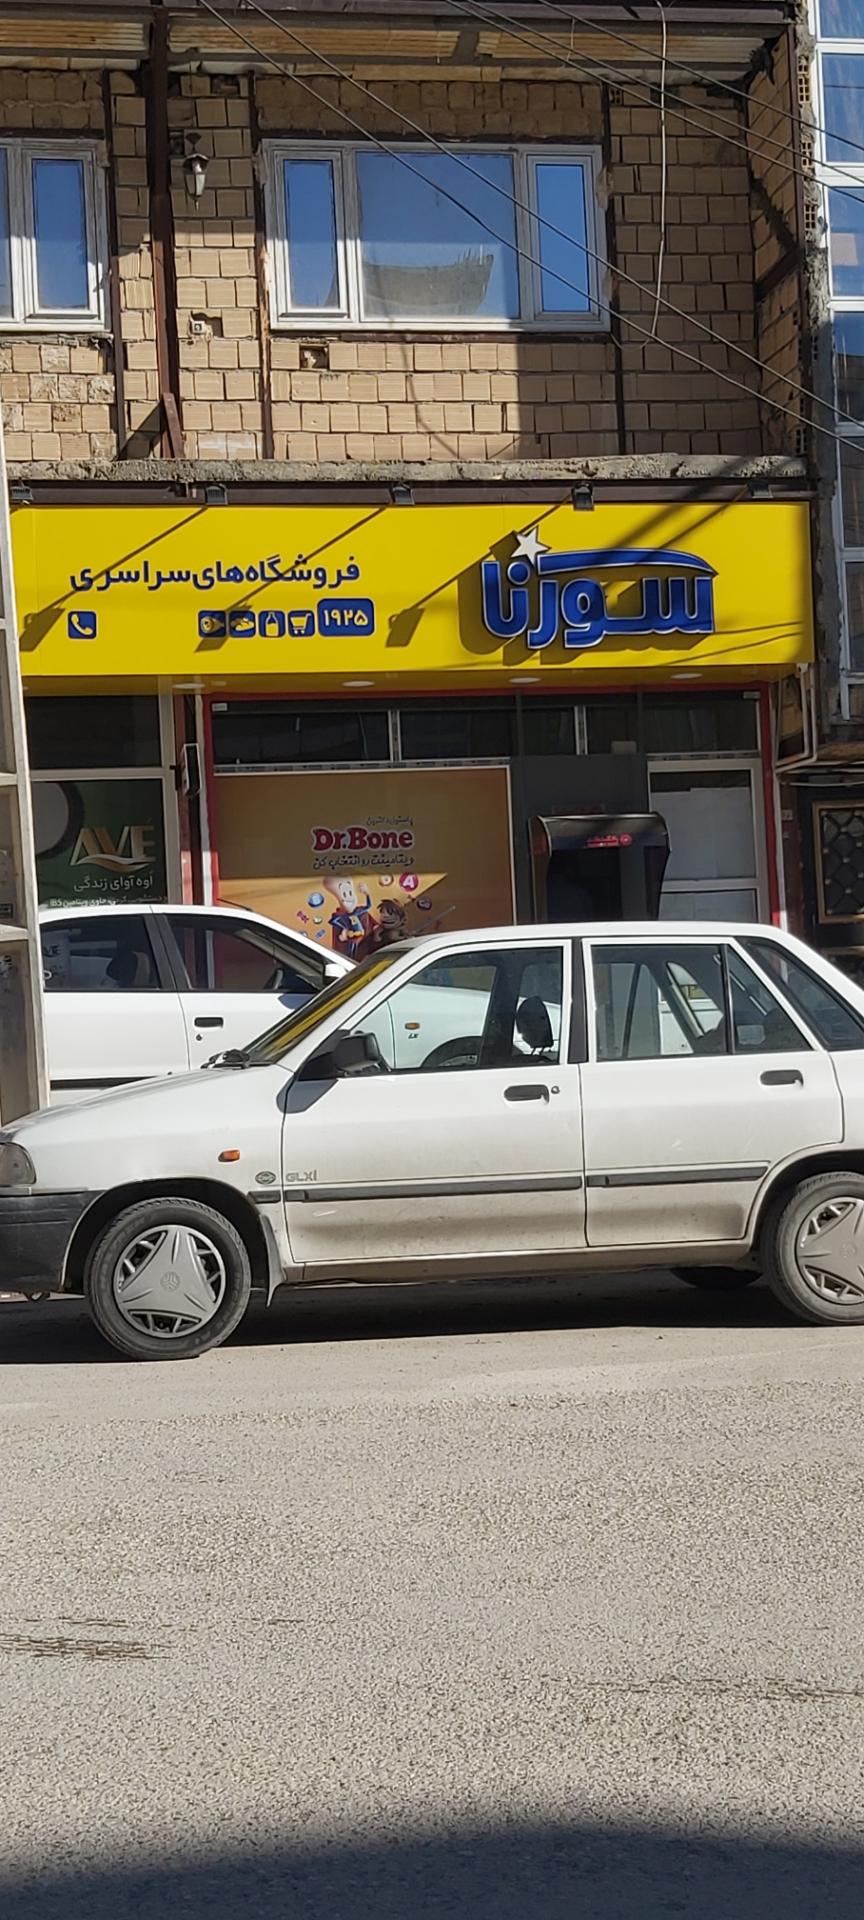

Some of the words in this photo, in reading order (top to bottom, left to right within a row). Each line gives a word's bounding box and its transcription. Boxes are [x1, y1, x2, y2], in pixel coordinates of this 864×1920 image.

[70, 561, 191, 592] سراسری
[481, 546, 717, 649] سورنا
[323, 607, 369, 627] ۱۹۲۵
[312, 826, 414, 852] Dr.Bone
[313, 856, 328, 870] کن
[329, 855, 361, 870] انتخاب
[73, 875, 108, 892] زندگی
[110, 874, 135, 890] آوای
